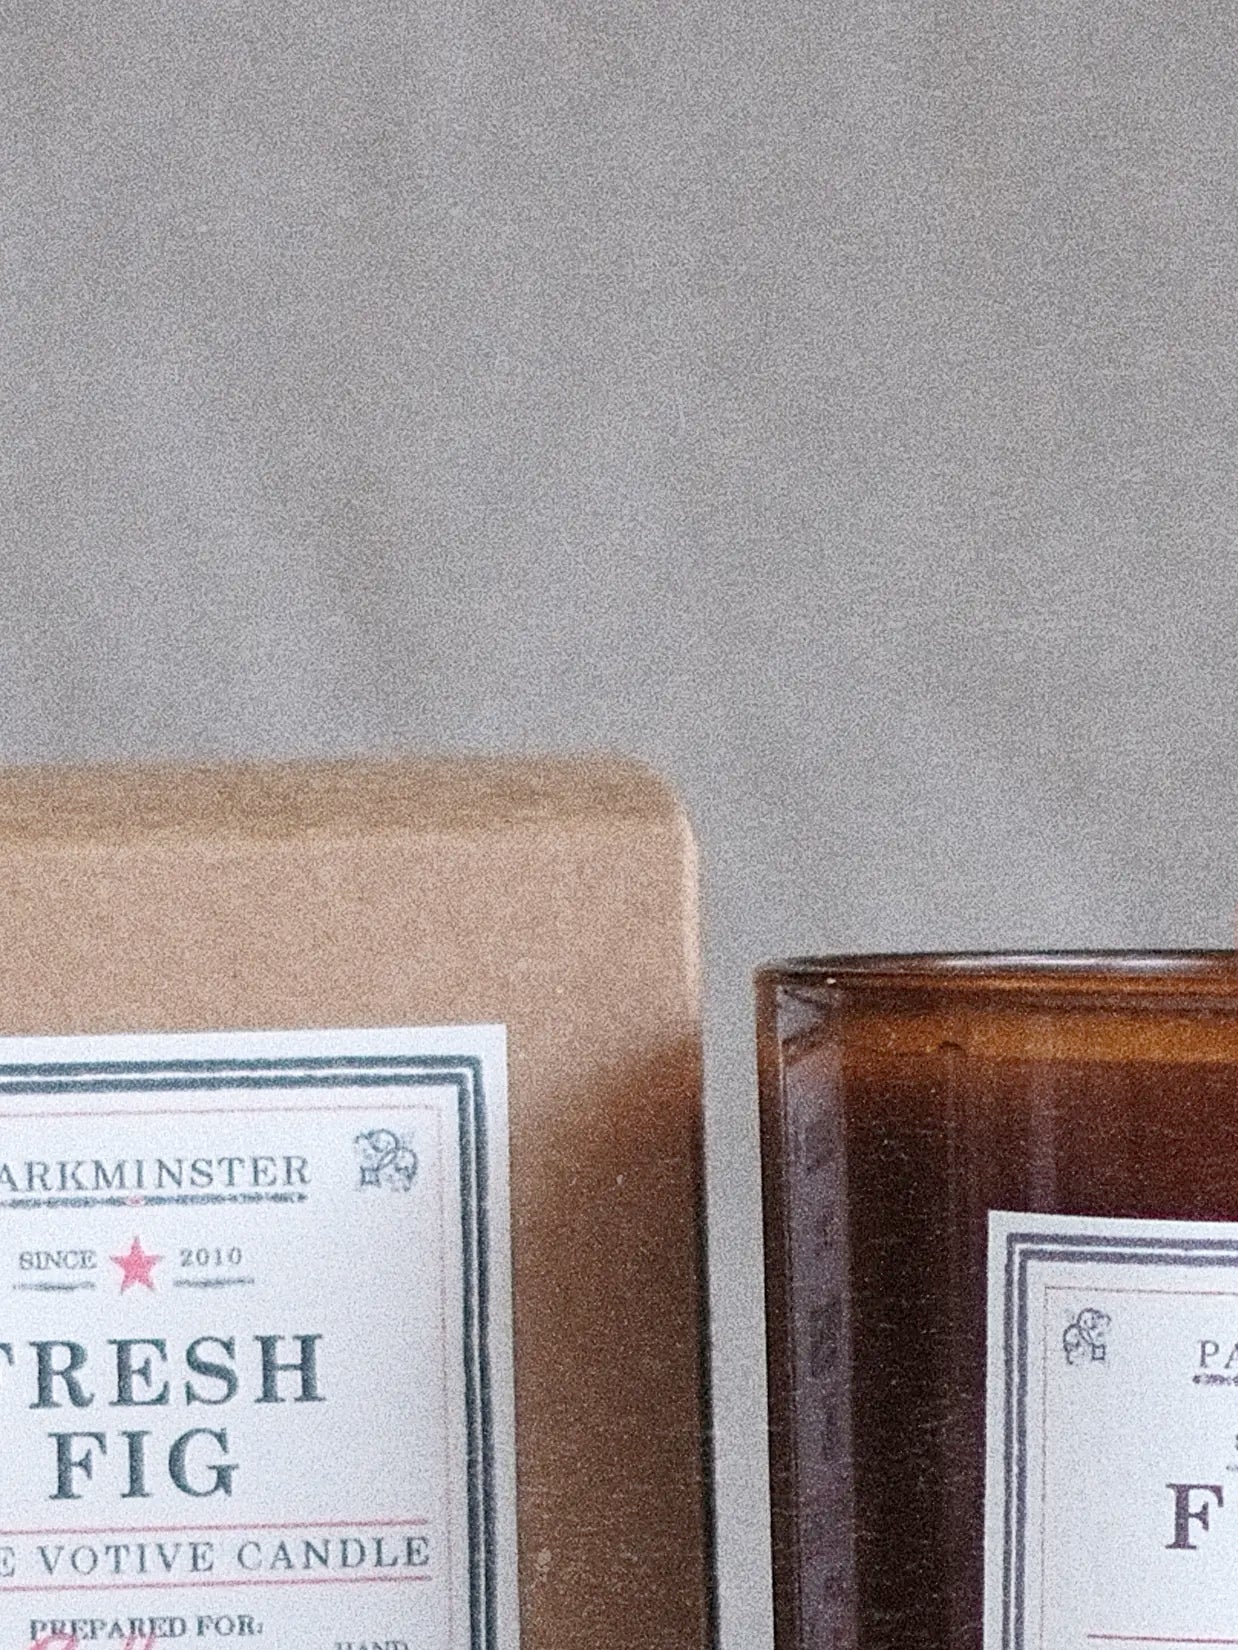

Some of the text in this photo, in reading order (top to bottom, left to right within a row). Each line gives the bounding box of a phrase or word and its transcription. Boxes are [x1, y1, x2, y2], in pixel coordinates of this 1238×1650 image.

[18, 1246, 243, 1270] SINCE 2010
[47, 1427, 239, 1501] FIG
[37, 1541, 214, 1575] VOTIVE
[236, 1534, 431, 1570] CANDLE
[26, 1613, 189, 1642] PREPARED
